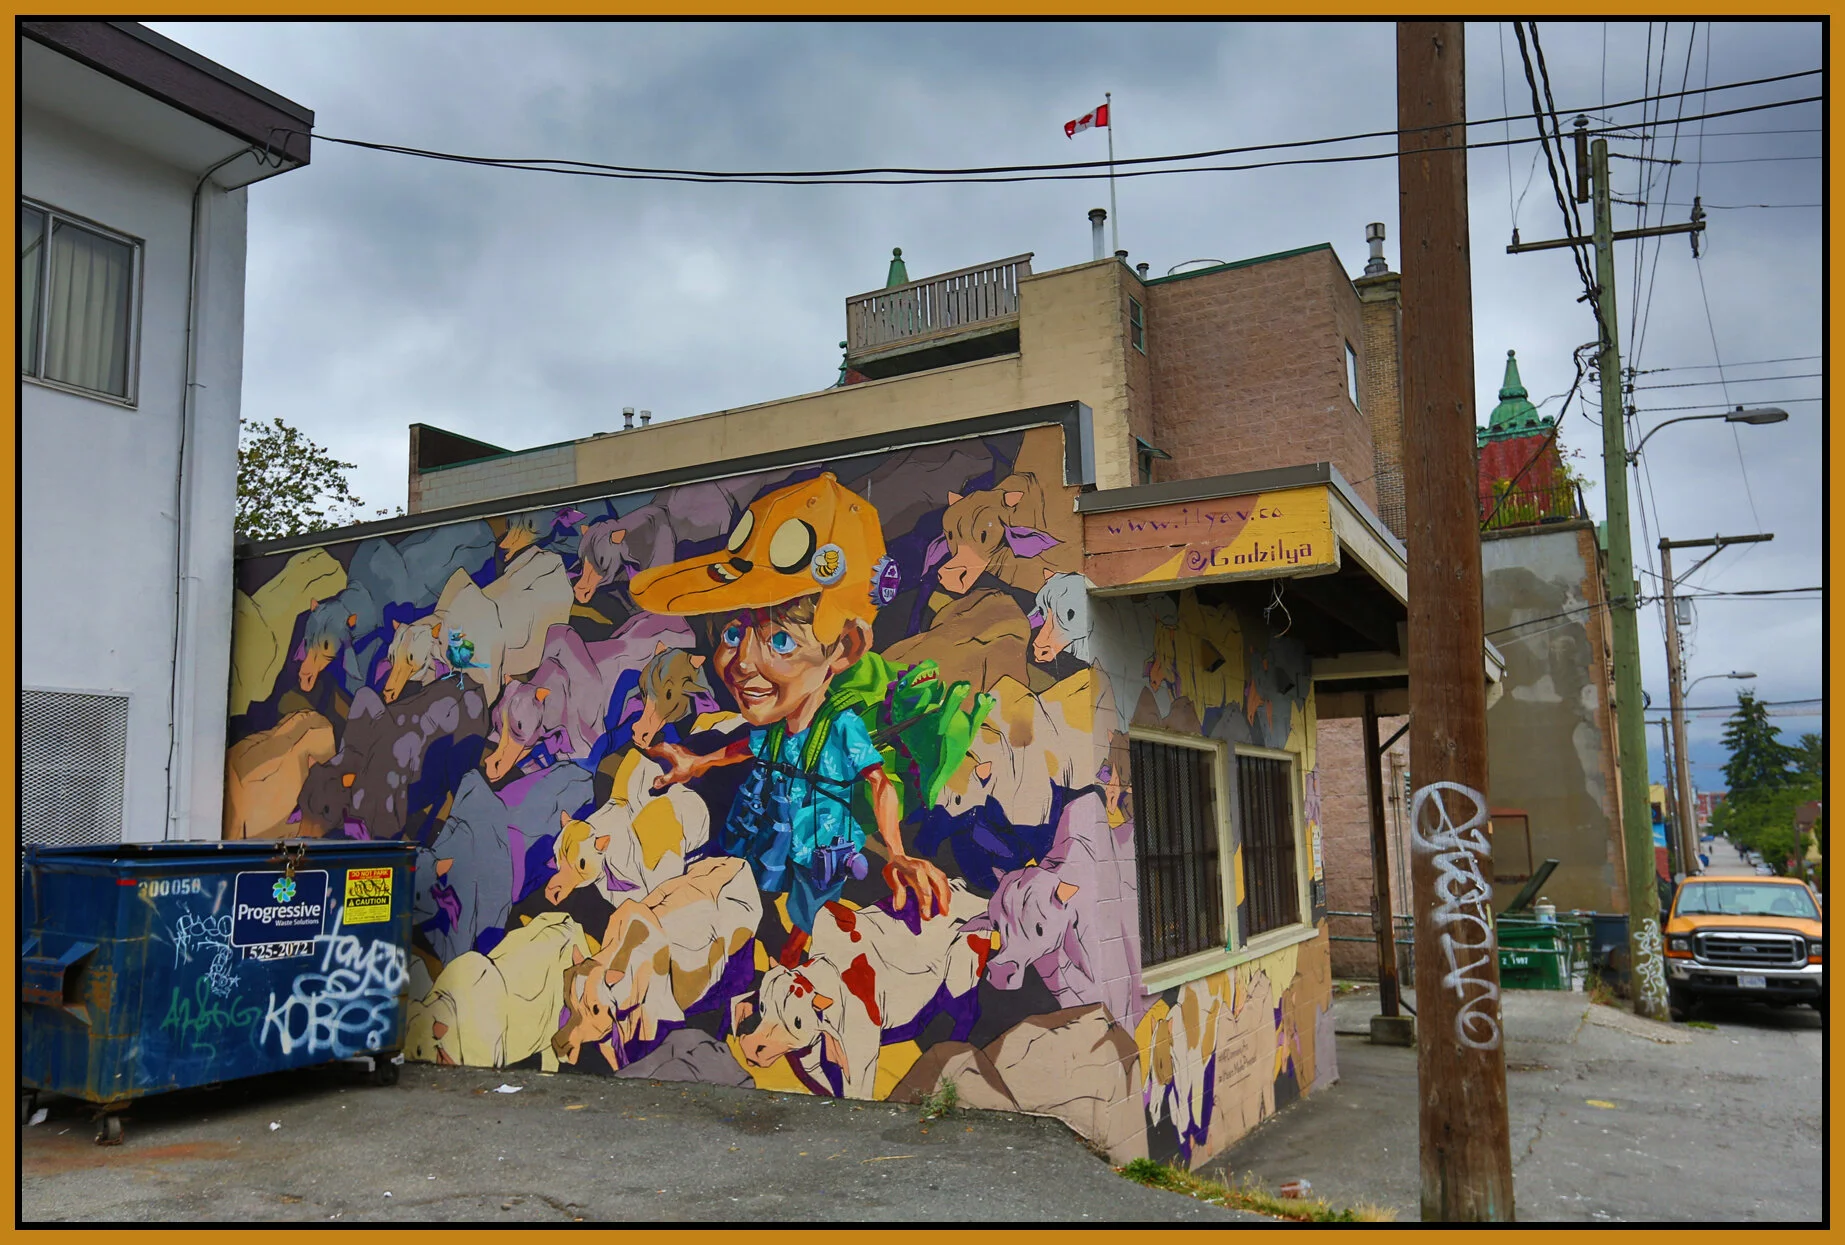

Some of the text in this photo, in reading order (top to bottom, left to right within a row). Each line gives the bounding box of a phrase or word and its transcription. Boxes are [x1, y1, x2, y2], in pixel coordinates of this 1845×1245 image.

[1107, 507, 1284, 535] www.ilyav.ca
[1186, 538, 1312, 571] @Godzilya
[238, 901, 321, 924] Progressive
[355, 898, 387, 906] CAUTION
[249, 942, 308, 960] 525-2072
